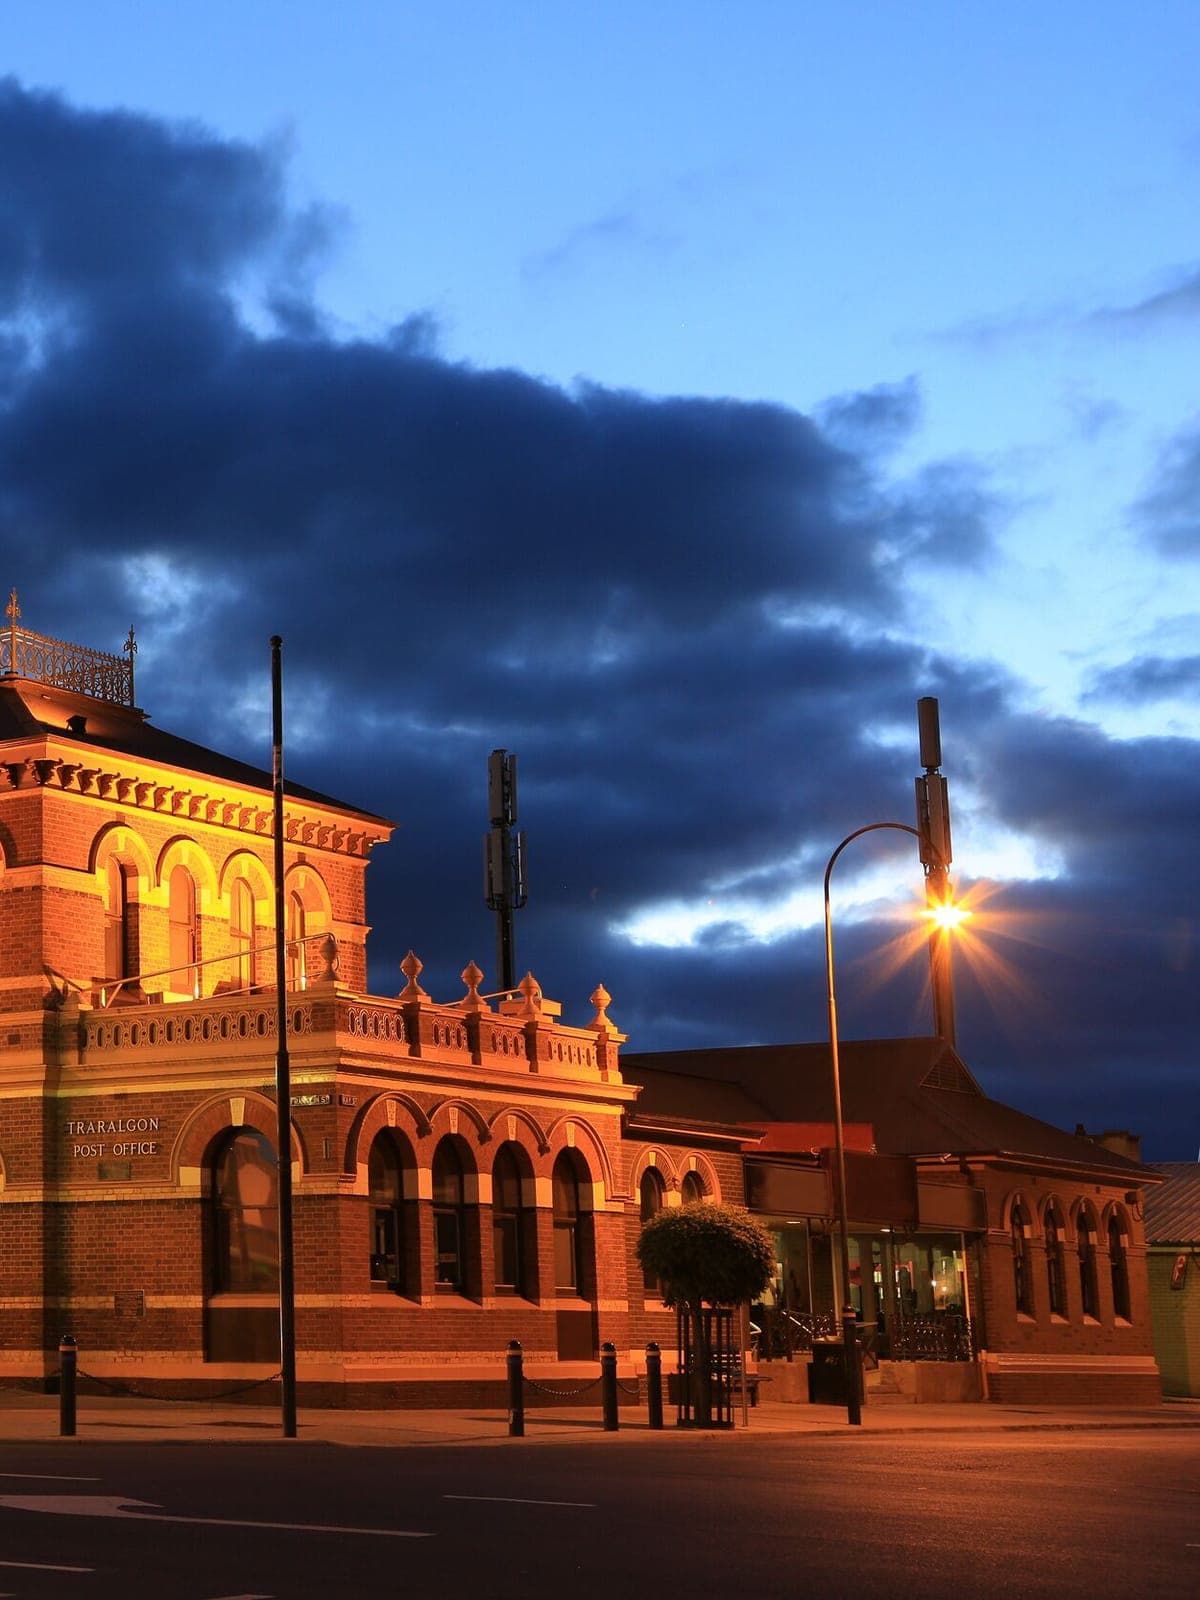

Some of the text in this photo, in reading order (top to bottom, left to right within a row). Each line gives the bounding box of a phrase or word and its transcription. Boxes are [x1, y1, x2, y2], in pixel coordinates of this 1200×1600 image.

[66, 1118, 159, 1134] TRARALGON
[73, 1141, 157, 1157] POST OFFICE
